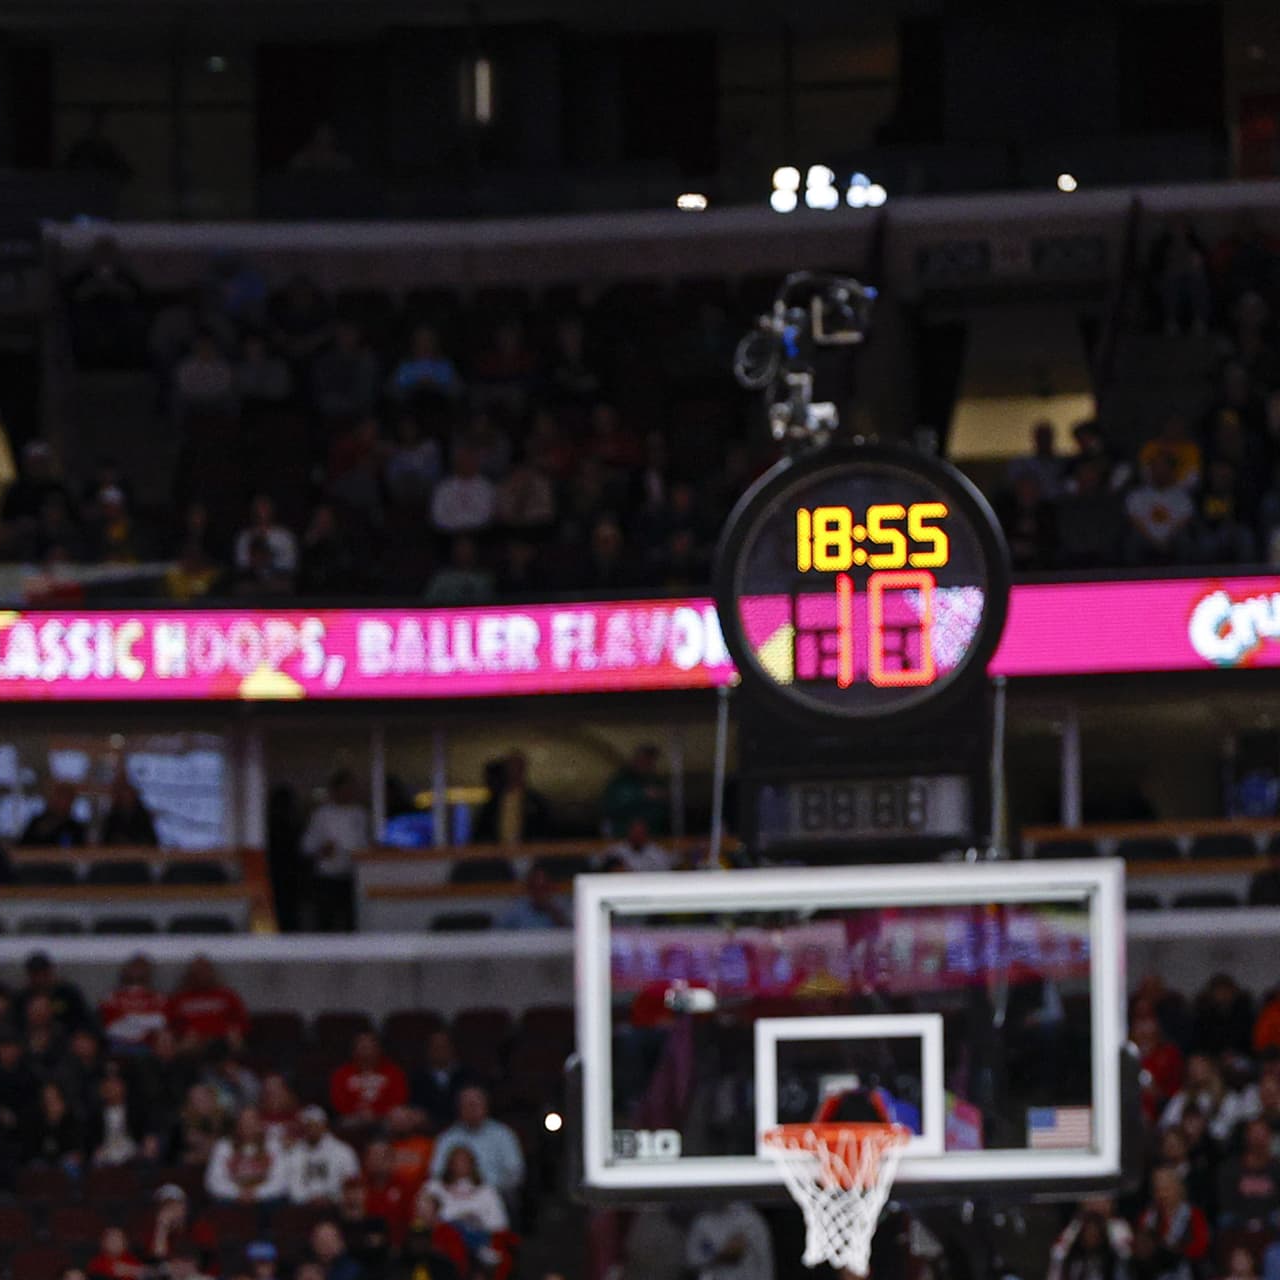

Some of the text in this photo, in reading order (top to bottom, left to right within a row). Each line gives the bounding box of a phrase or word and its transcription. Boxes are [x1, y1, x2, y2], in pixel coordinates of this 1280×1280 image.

[796, 503, 949, 572] 18:55
[153, 617, 345, 690] HOOPS,
[357, 614, 540, 676] BALLER
[836, 569, 938, 688] 10
